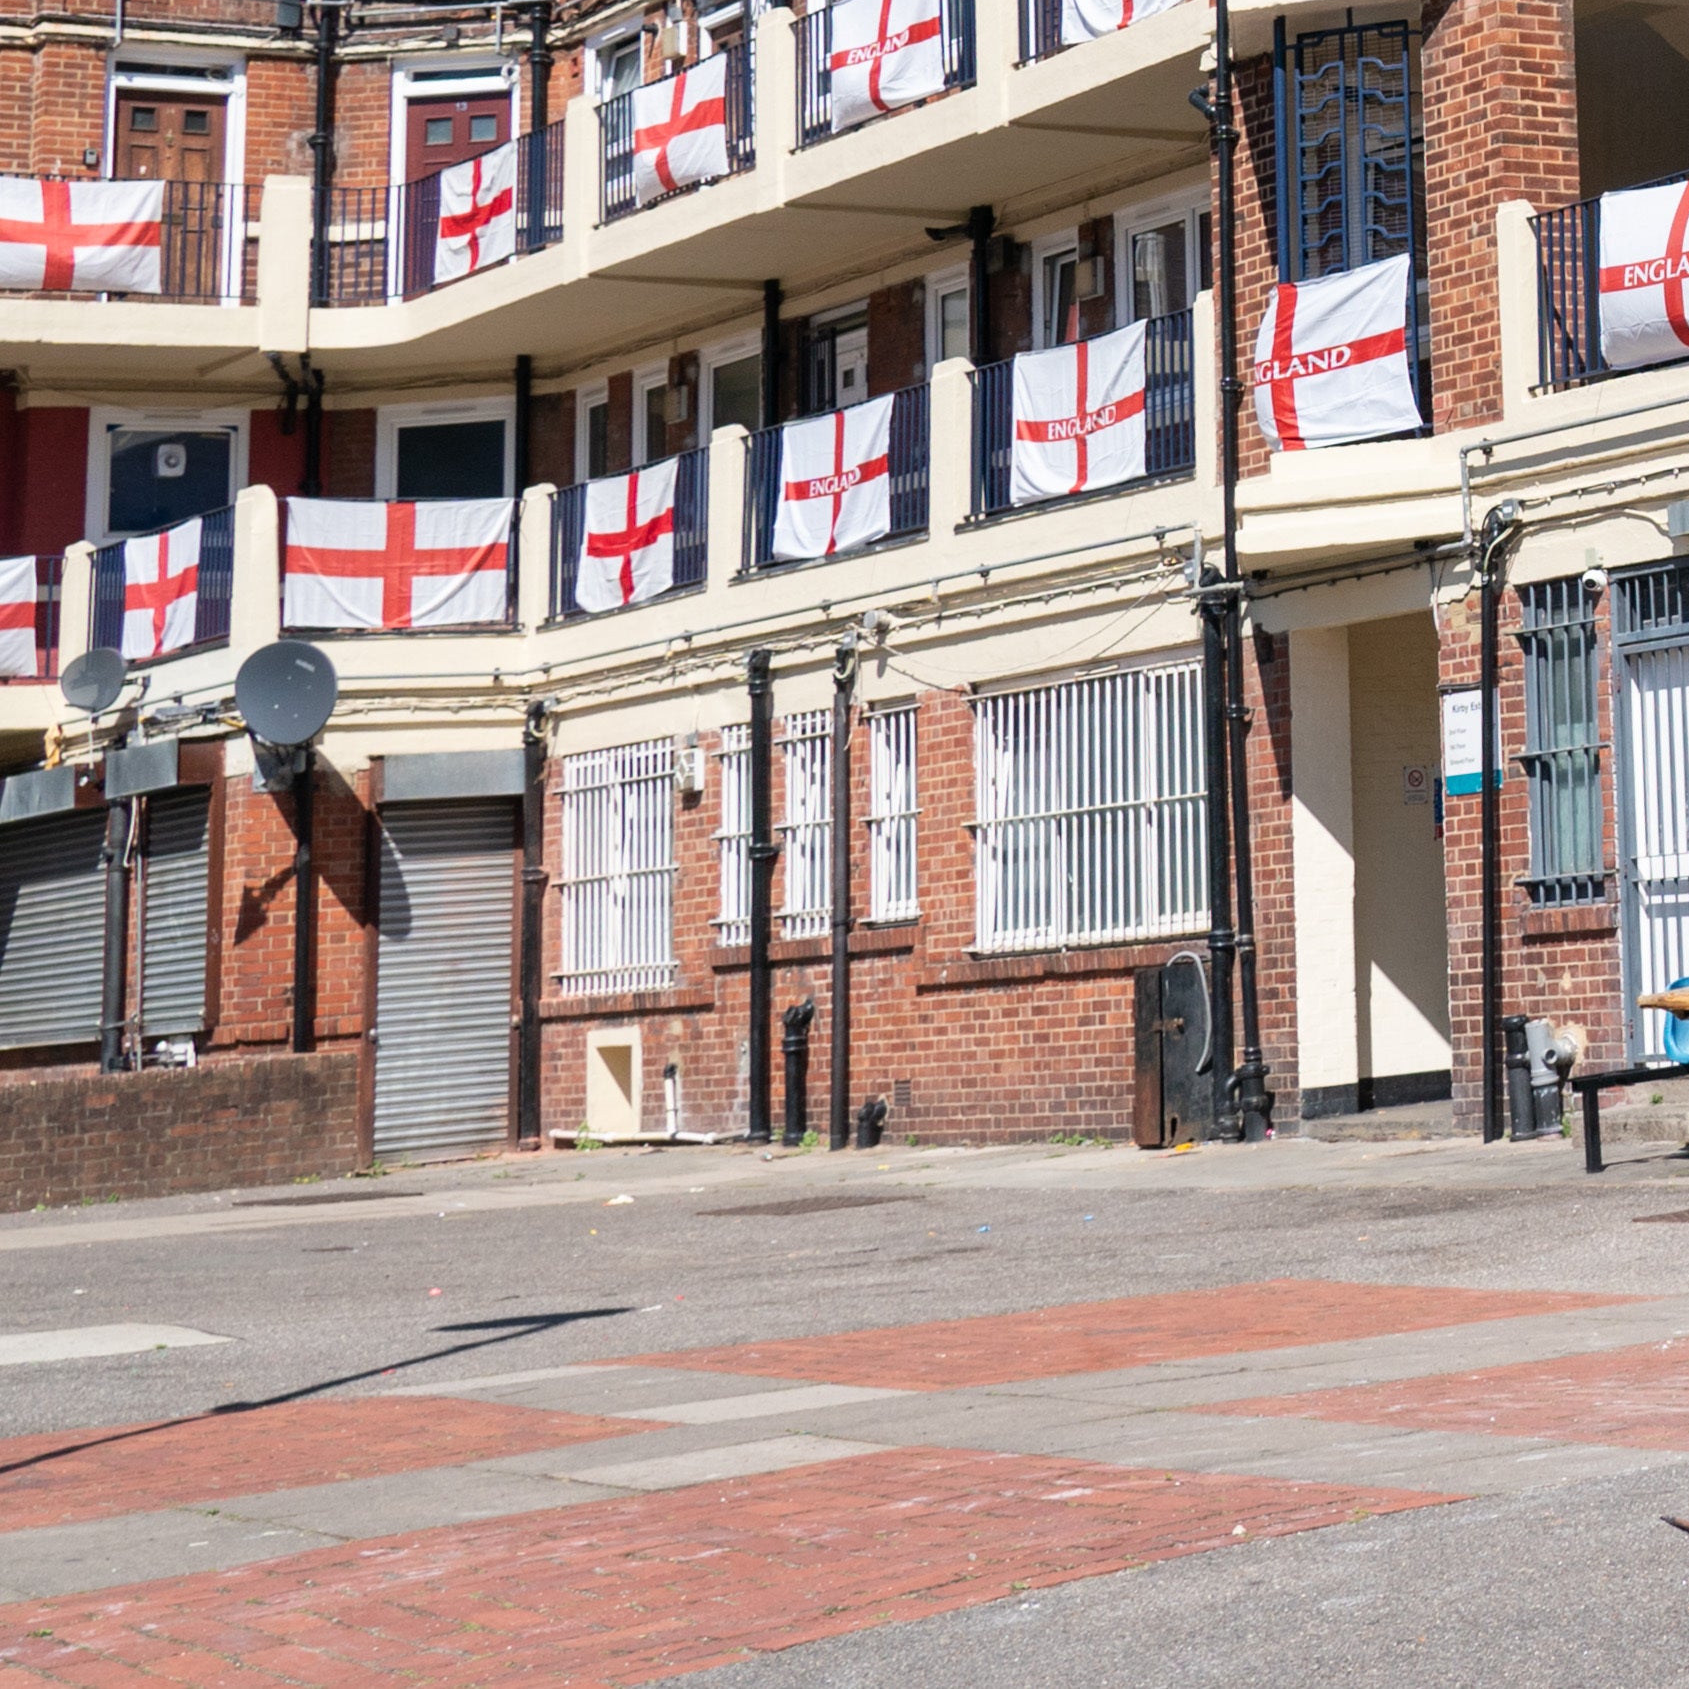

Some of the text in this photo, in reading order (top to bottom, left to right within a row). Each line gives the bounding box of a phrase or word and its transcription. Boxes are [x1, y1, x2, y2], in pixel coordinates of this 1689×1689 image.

[846, 30, 909, 66] ENGLAND
[1047, 405, 1117, 441] ENGLAND
[809, 467, 861, 498] ENGLAND
[1452, 704, 1469, 714] Kirby
